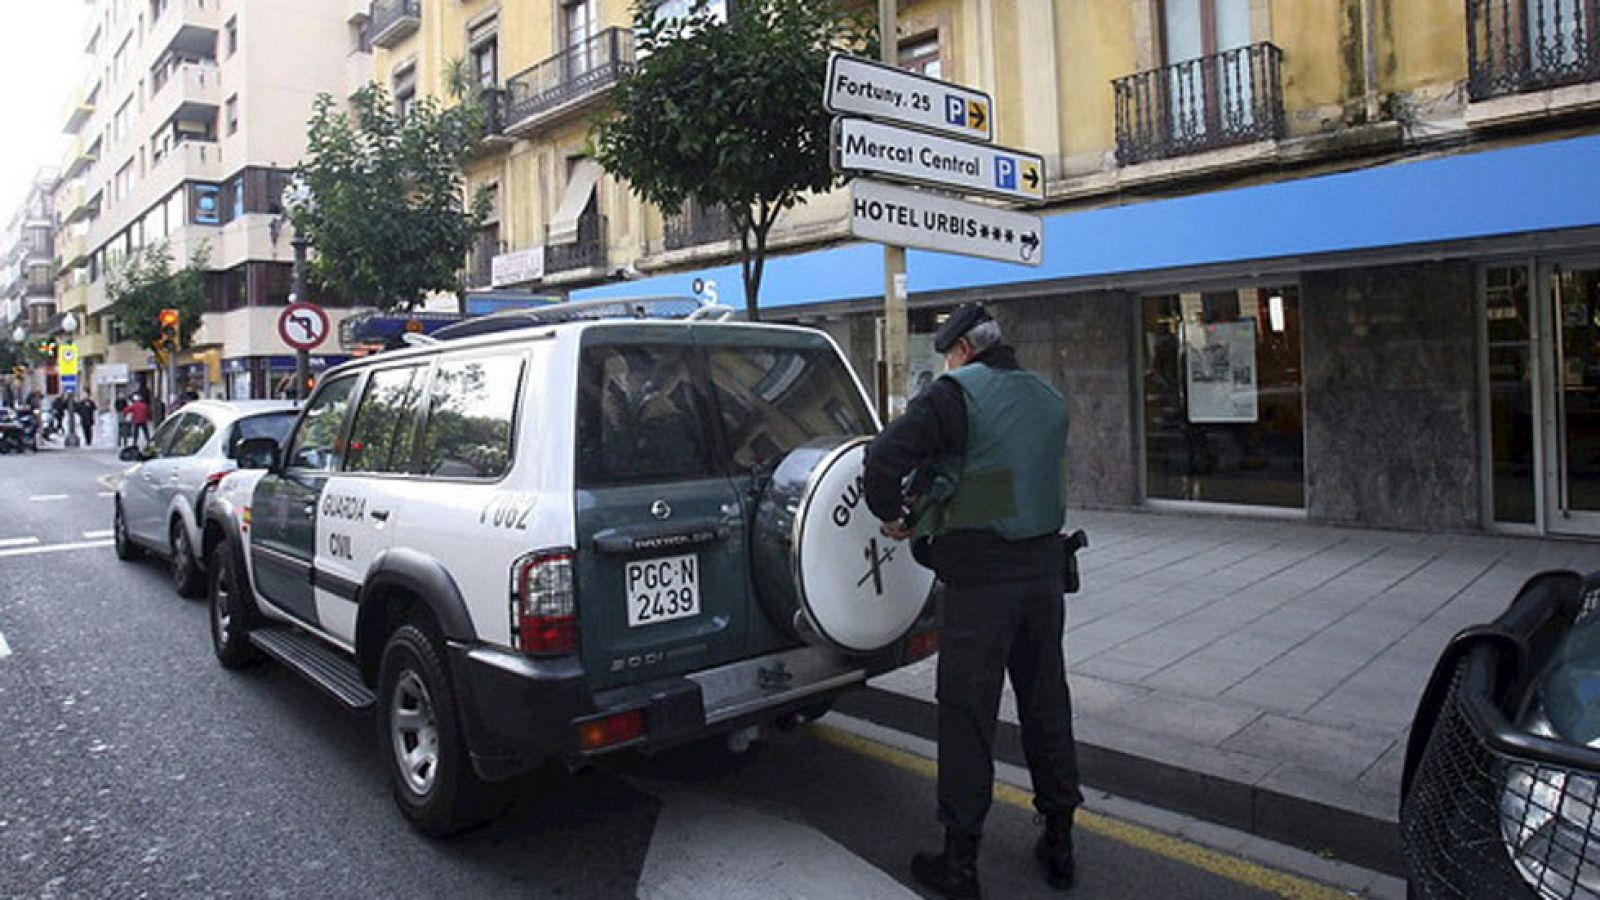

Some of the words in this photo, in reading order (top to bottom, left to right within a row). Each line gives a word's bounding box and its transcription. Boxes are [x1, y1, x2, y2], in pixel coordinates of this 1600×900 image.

[911, 92, 931, 112] 25
[846, 133, 914, 163] Mercat
[919, 146, 981, 177] Central
[853, 197, 919, 228] HOTEL
[637, 586, 693, 620] 2439
